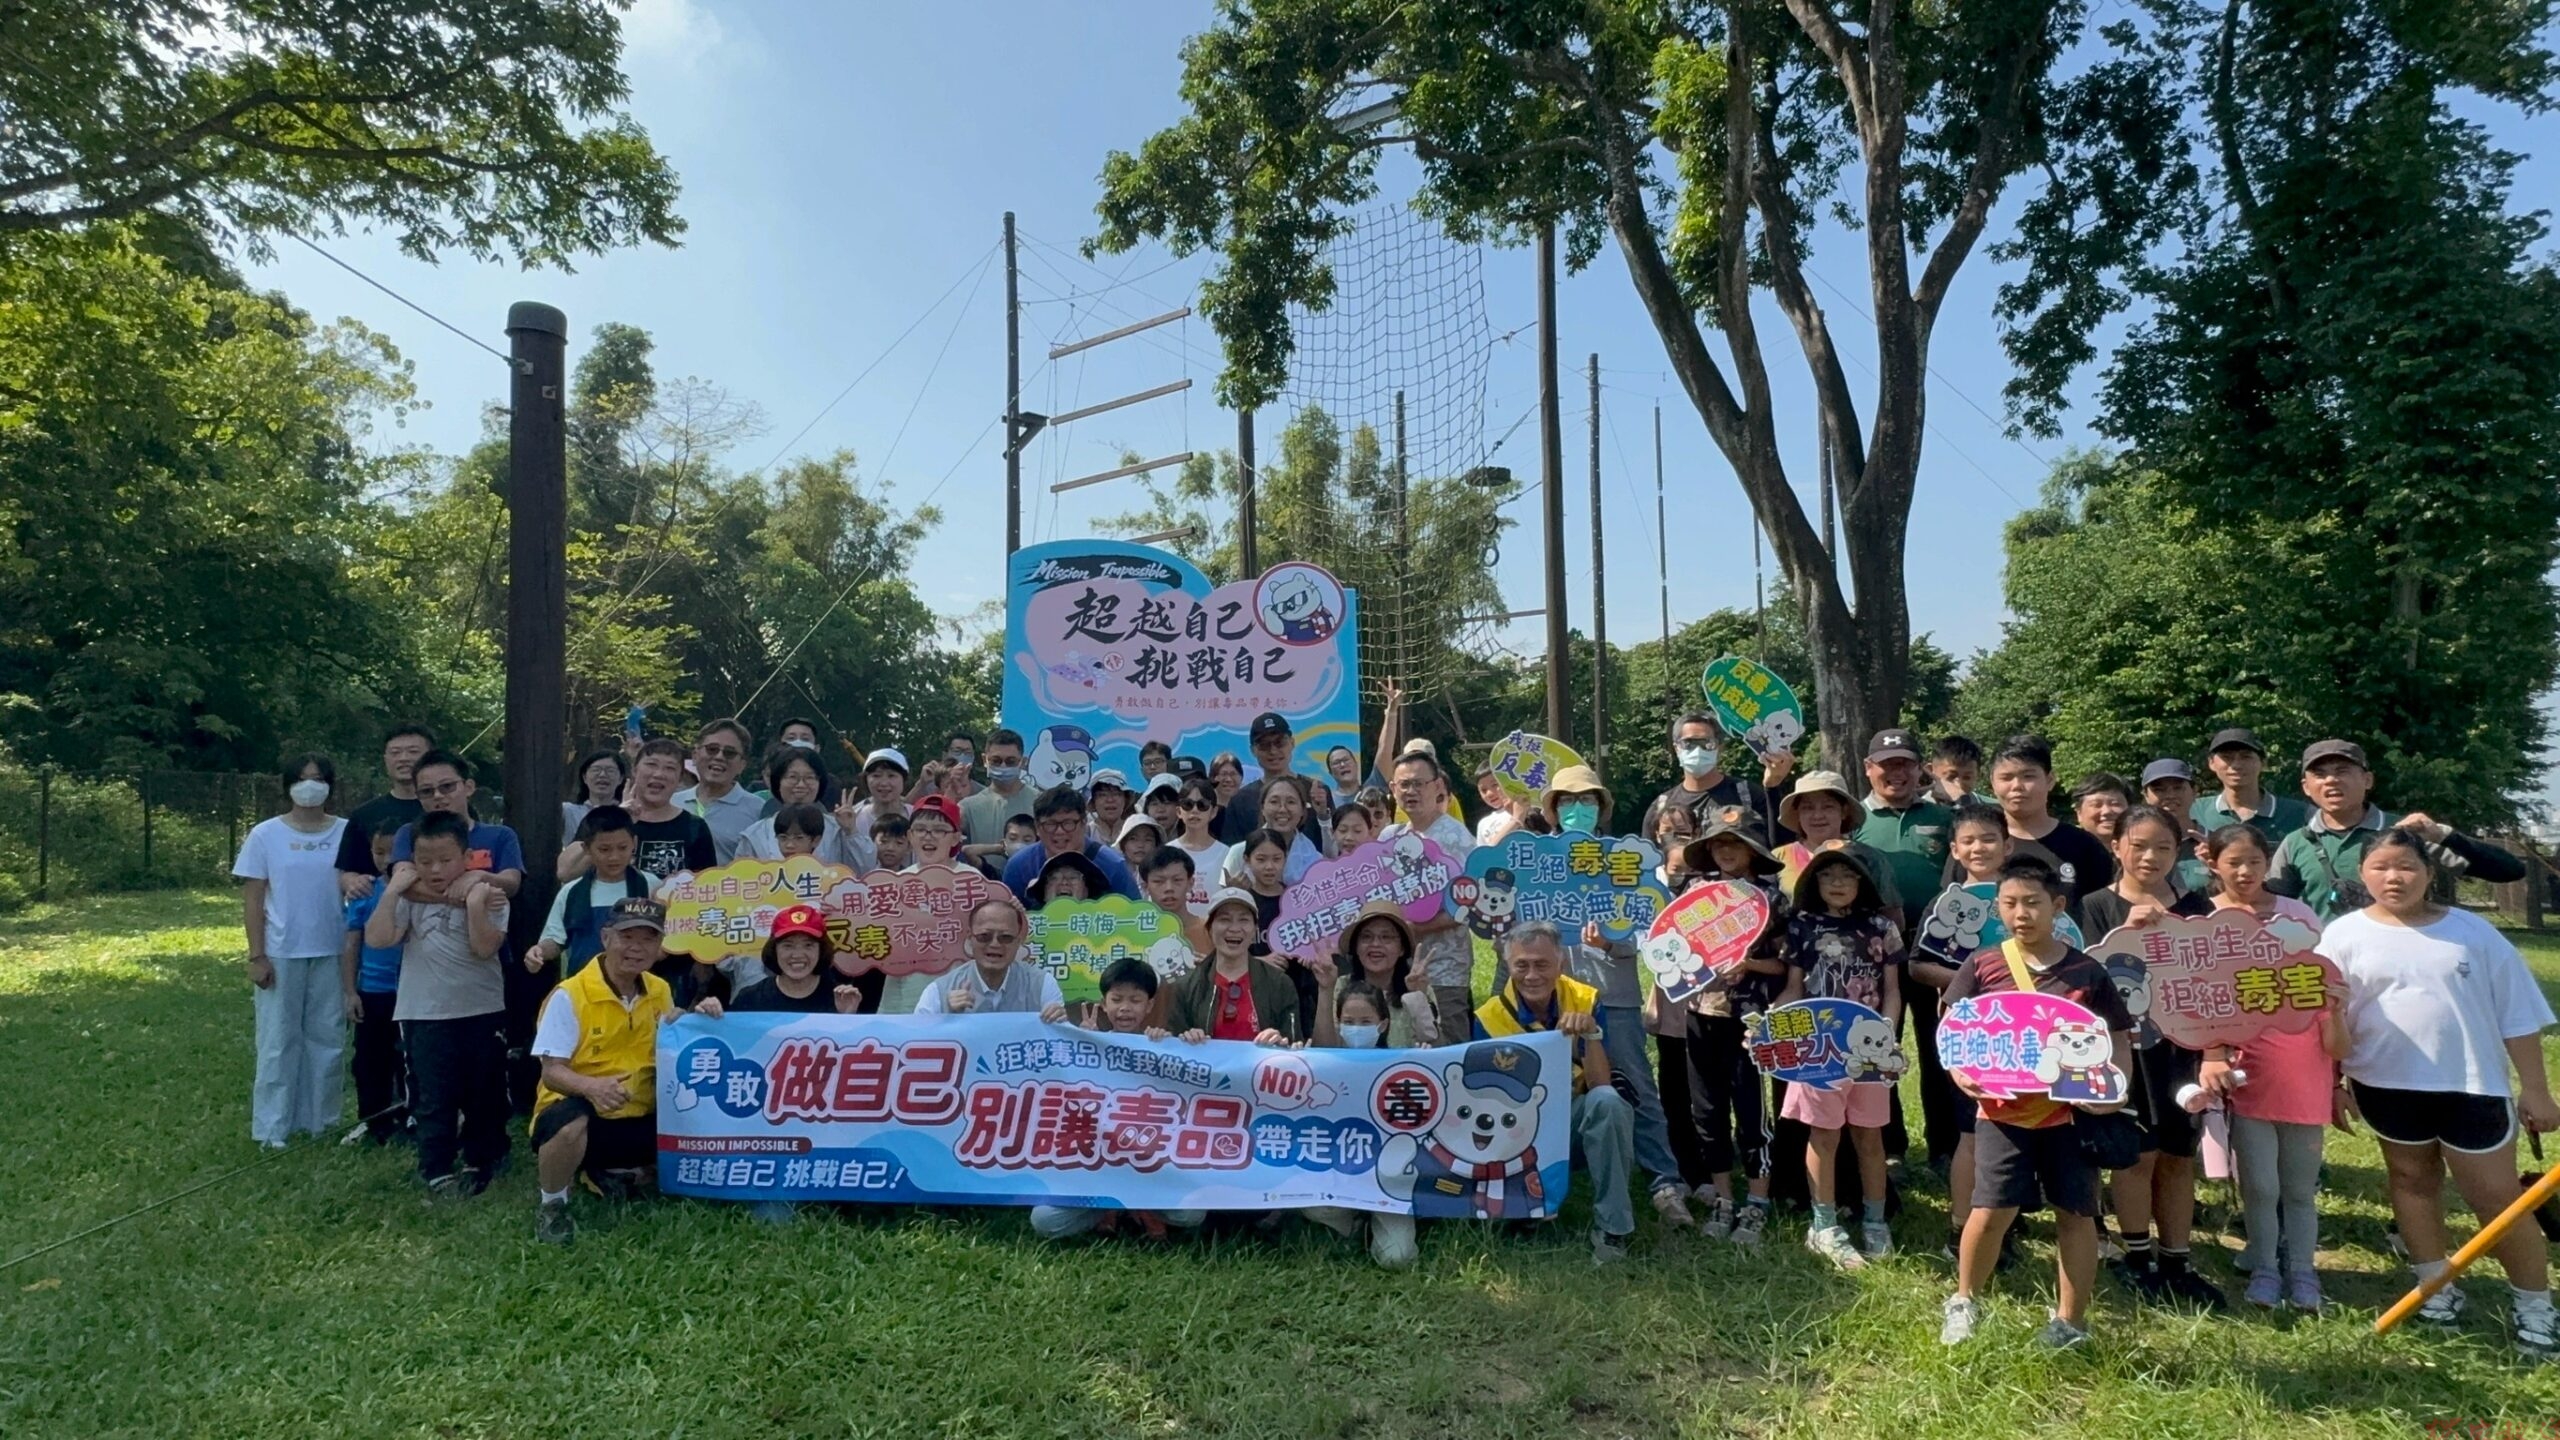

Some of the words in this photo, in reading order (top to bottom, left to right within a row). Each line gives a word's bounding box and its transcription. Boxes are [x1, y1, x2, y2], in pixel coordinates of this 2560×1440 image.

[1029, 560, 1090, 580] Mission
[1100, 562, 1171, 583] Impossible
[1063, 587, 1256, 644] 超越自己
[1125, 645, 1296, 693] 挑戰自己
[1495, 752, 1547, 789] 反毒
[1508, 840, 1641, 887] 拒絕毒害
[675, 867, 822, 903] 活出自己的人生
[841, 876, 988, 918] 用愛牽起手
[1290, 862, 1380, 909] 珍惜生命
[1452, 884, 1478, 899] NO
[625, 903, 657, 914] NAVY
[1517, 890, 1656, 925] 前途無礙
[825, 919, 962, 960] 反毒不失守
[2141, 924, 2284, 970] 重視生命
[2159, 963, 2326, 1018] 拒絕毒害
[1953, 999, 2013, 1022] 本人
[997, 1041, 1101, 1073] 拒絕毒品
[1106, 1046, 1212, 1088] 從我做起
[1259, 1065, 1307, 1100] NO!
[1384, 1079, 1431, 1127] 毒
[677, 1139, 727, 1151] MISSION
[728, 1140, 799, 1151] IMPOSSIBLE
[677, 1157, 776, 1187] 超越自己
[782, 1159, 906, 1189] 挑戰自己!
